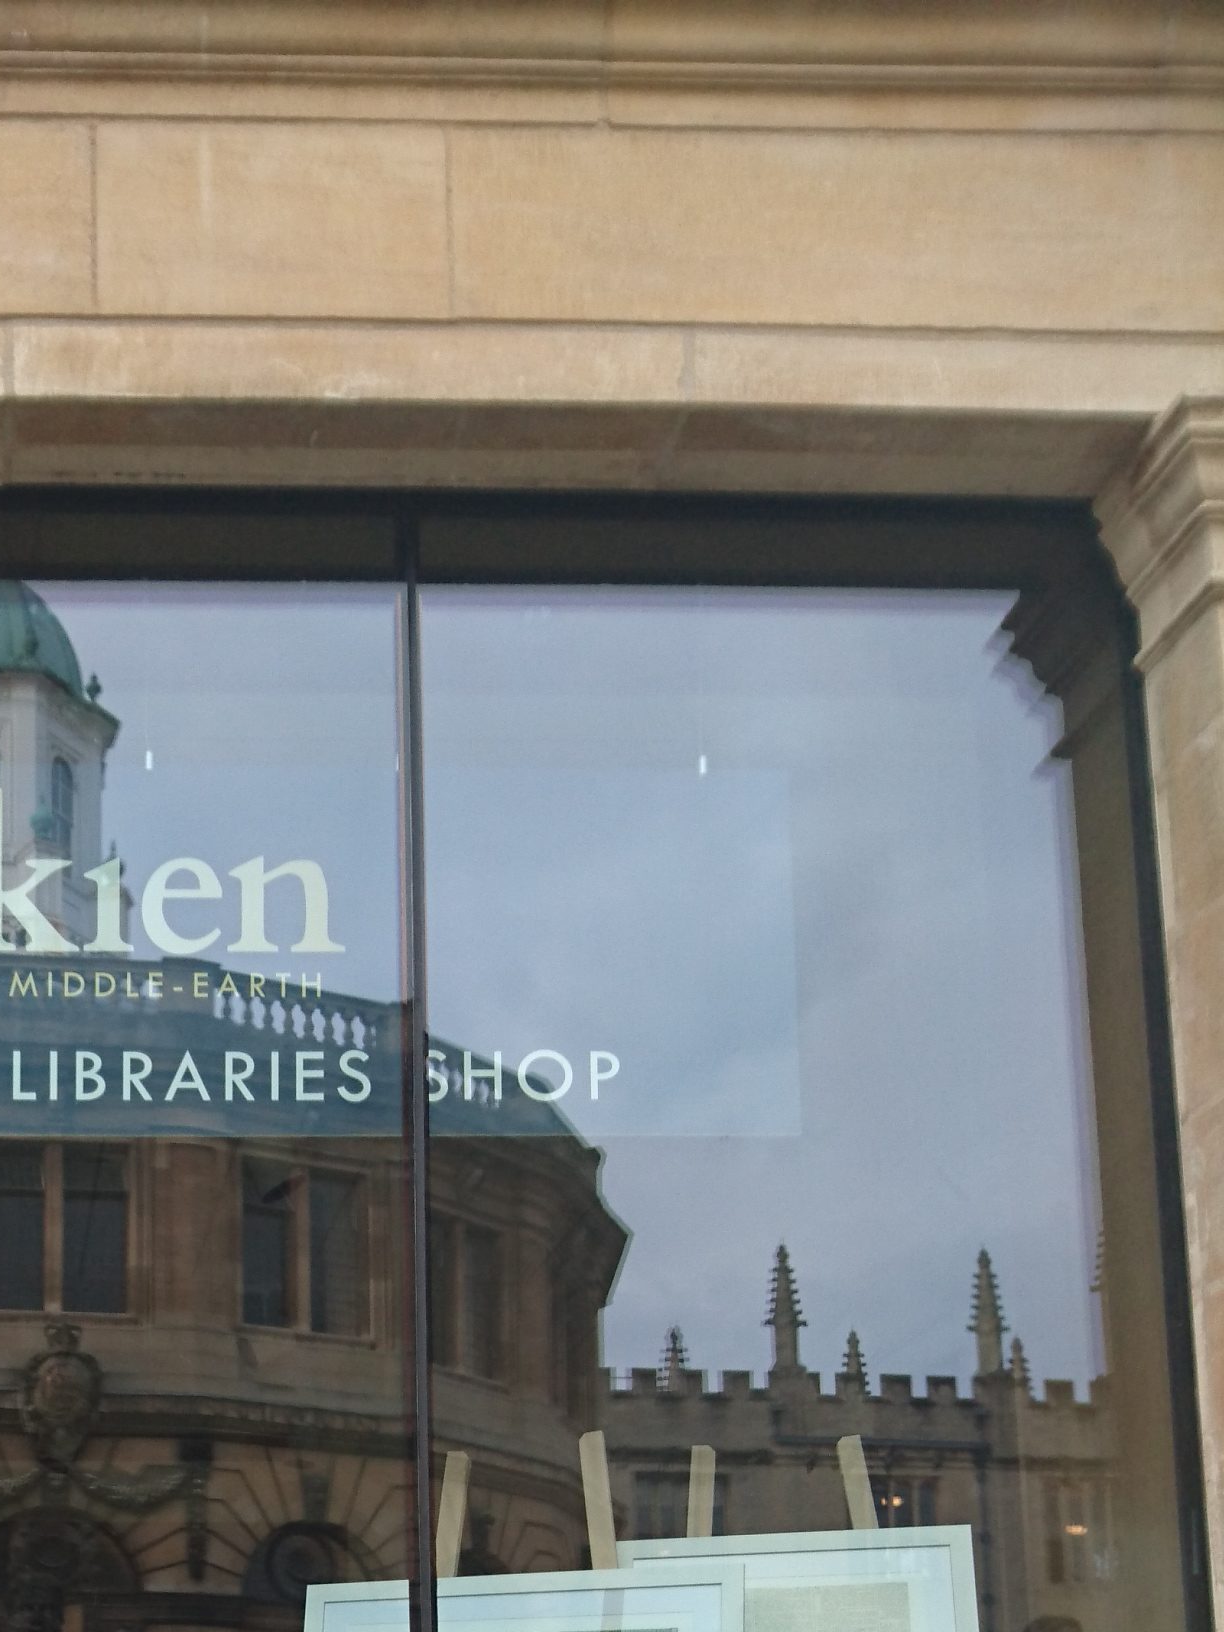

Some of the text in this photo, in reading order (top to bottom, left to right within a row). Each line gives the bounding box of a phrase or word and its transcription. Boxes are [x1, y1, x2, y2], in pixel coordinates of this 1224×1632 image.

[9, 971, 324, 999] MIDDLE-EARTH
[12, 1049, 372, 1102] LIBRARIES
[426, 1048, 621, 1101] SHOP
